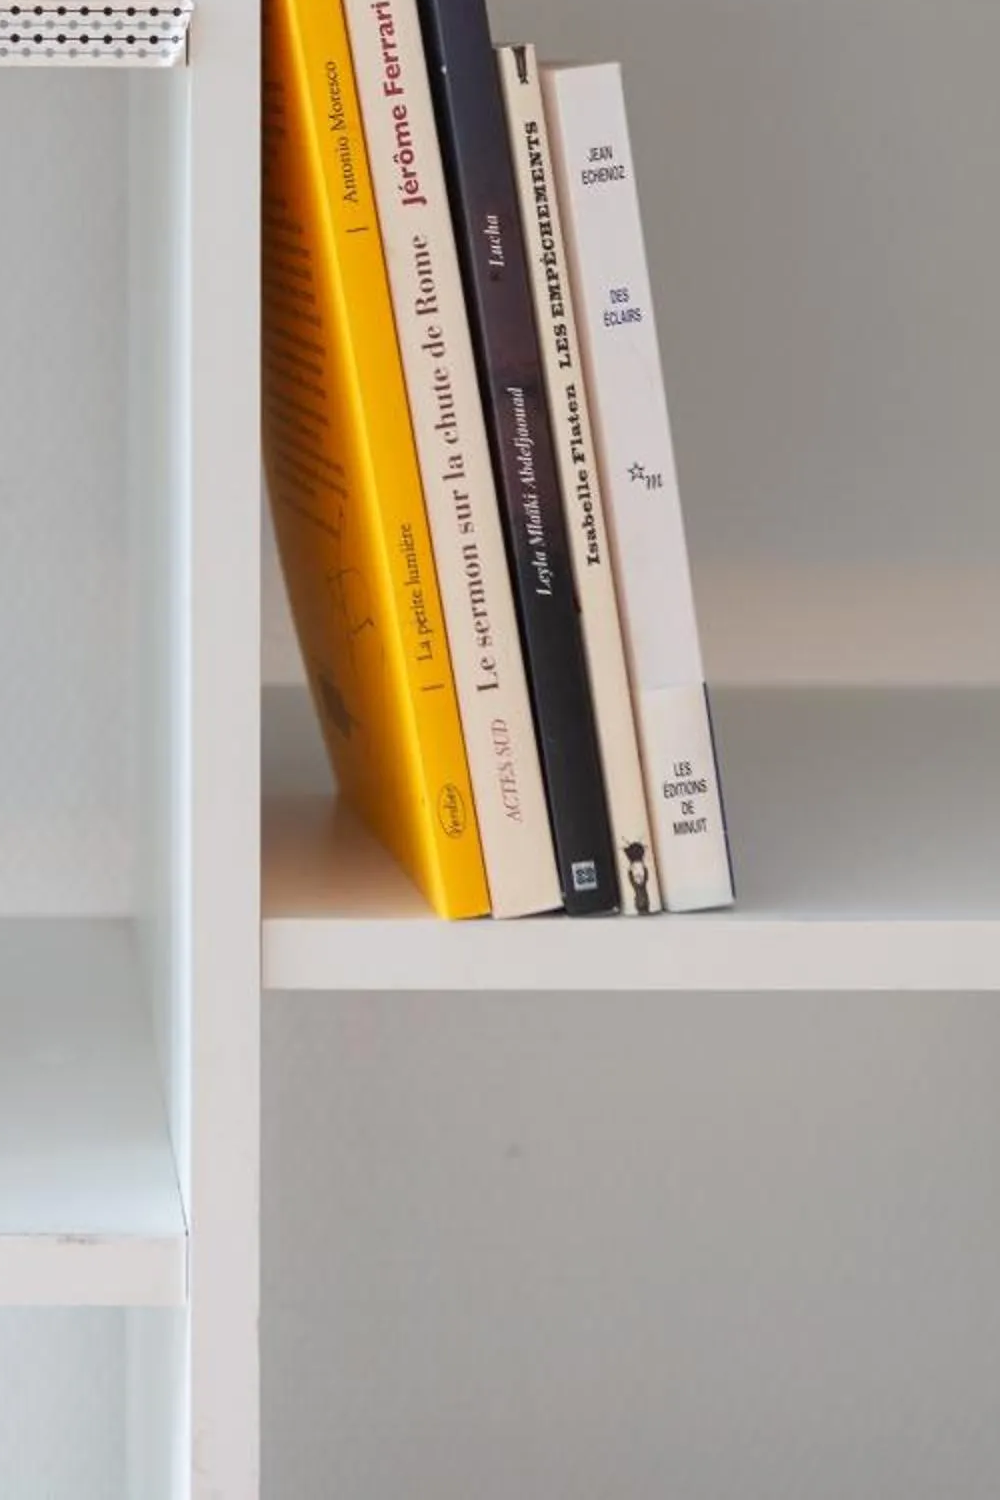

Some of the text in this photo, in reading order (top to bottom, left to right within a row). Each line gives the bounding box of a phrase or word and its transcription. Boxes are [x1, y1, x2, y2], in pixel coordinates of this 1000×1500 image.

[370, 0, 428, 207] Jérôme Ferrari
[323, 60, 359, 204] Antonio Moresco
[587, 146, 613, 163] JEAN
[581, 165, 626, 186] ECHENOZ
[482, 214, 505, 268] Lucha
[609, 288, 630, 304] DES
[552, 325, 573, 369] LES
[411, 234, 500, 693] Le sermon sur la chute de Rome
[565, 383, 600, 566] Isabelle Flaten
[400, 522, 434, 662] La petite lumière
[531, 551, 553, 596] Leyla
[490, 718, 523, 824] ACTES SUD
[674, 761, 692, 777] LES
[673, 818, 708, 836] MINUIT
[681, 801, 695, 816] DE
